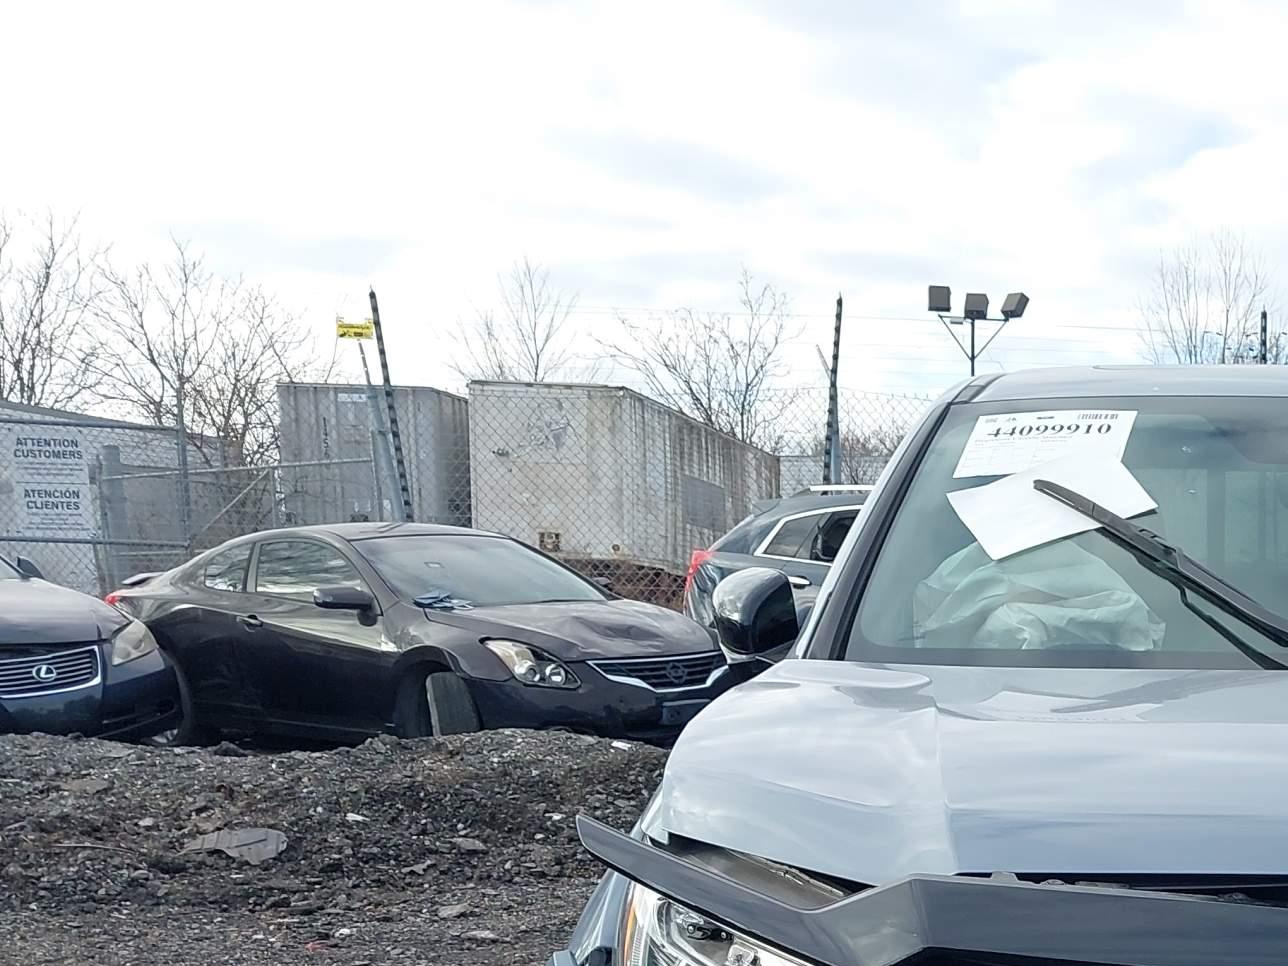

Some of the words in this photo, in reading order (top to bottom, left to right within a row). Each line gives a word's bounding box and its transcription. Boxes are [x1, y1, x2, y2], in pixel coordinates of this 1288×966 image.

[987, 423, 1112, 438] 44099910
[16, 437, 79, 449] ATTENTION
[14, 448, 83, 460] CUSTOMERS
[26, 500, 81, 511] CLIENTES
